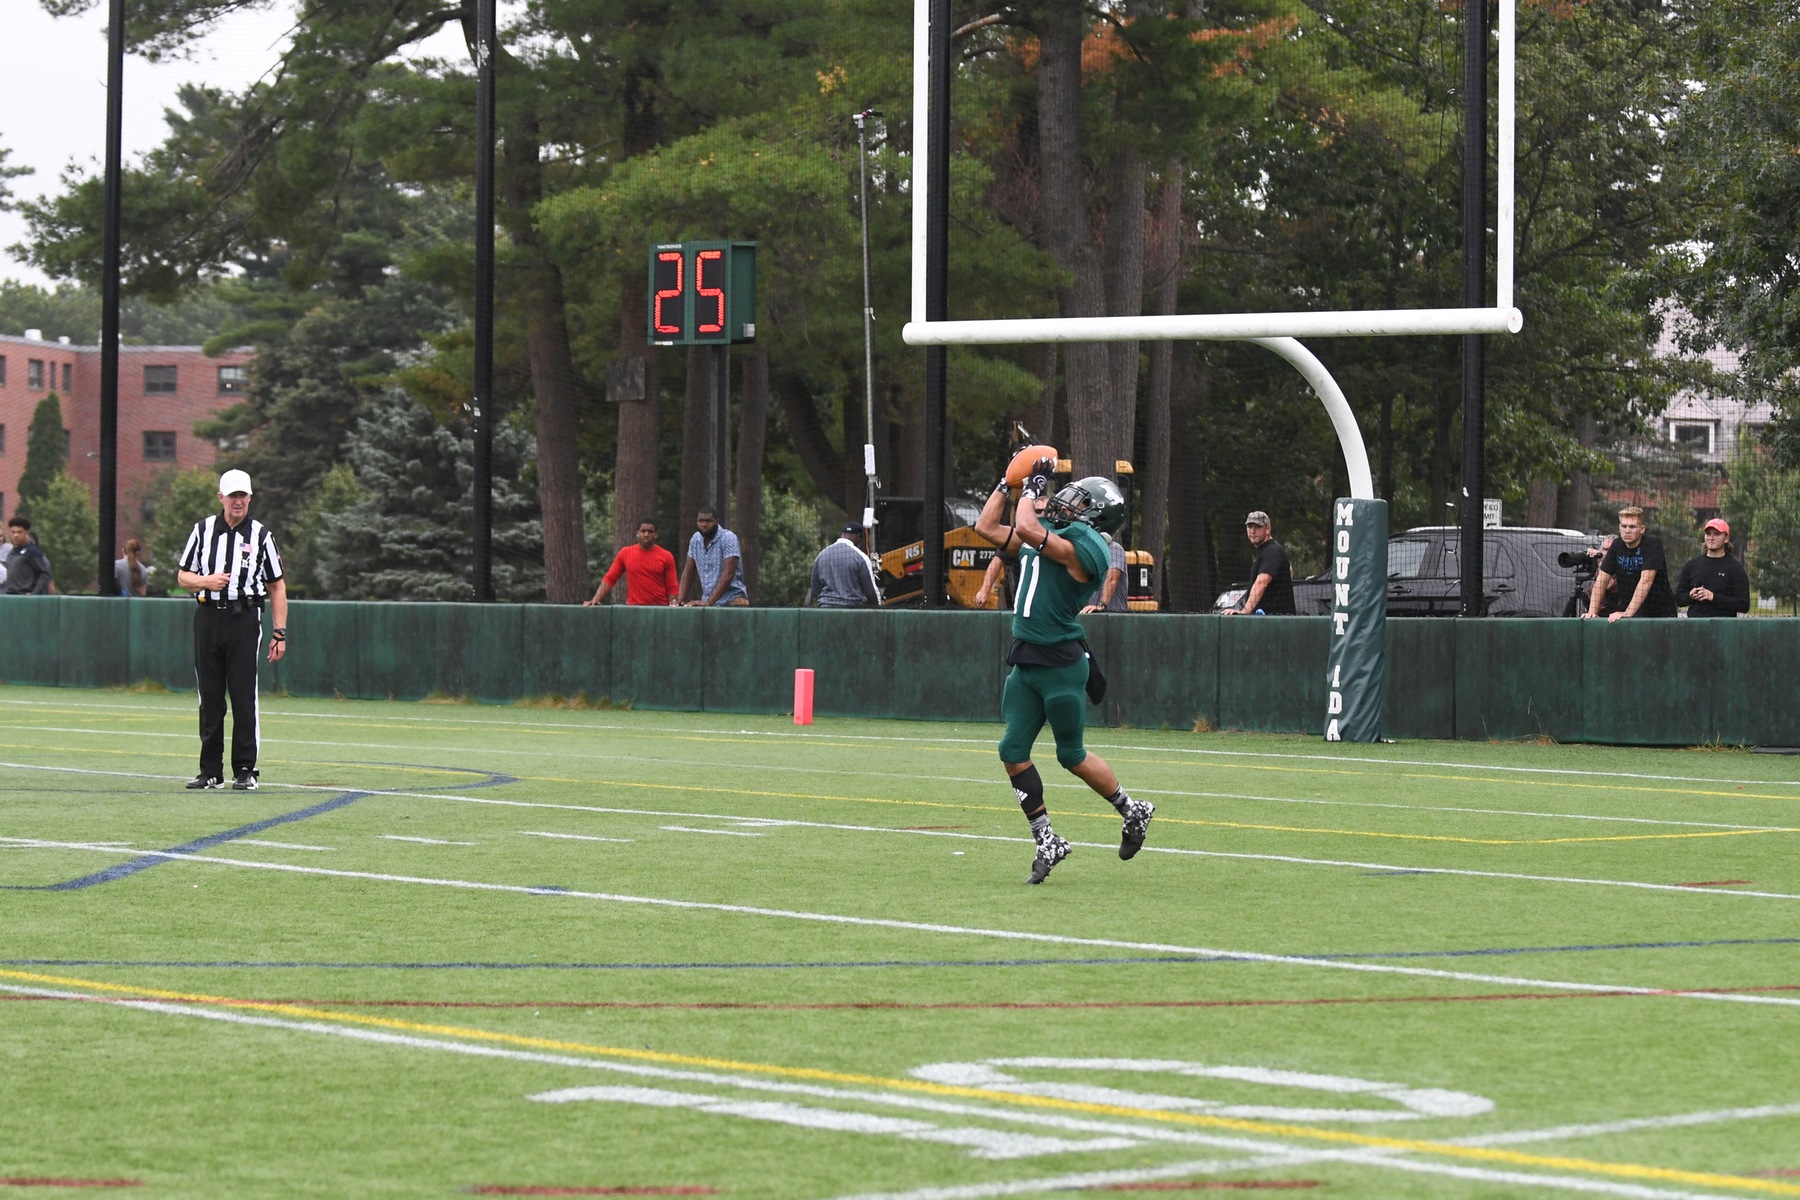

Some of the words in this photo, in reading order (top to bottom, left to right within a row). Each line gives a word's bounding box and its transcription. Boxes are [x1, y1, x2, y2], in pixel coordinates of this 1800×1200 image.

[654, 250, 725, 334] 25
[952, 549, 977, 567] CAT
[1013, 554, 1040, 618] 11
[1333, 503, 1354, 635] MOUNT
[1326, 665, 1343, 742] IDA
